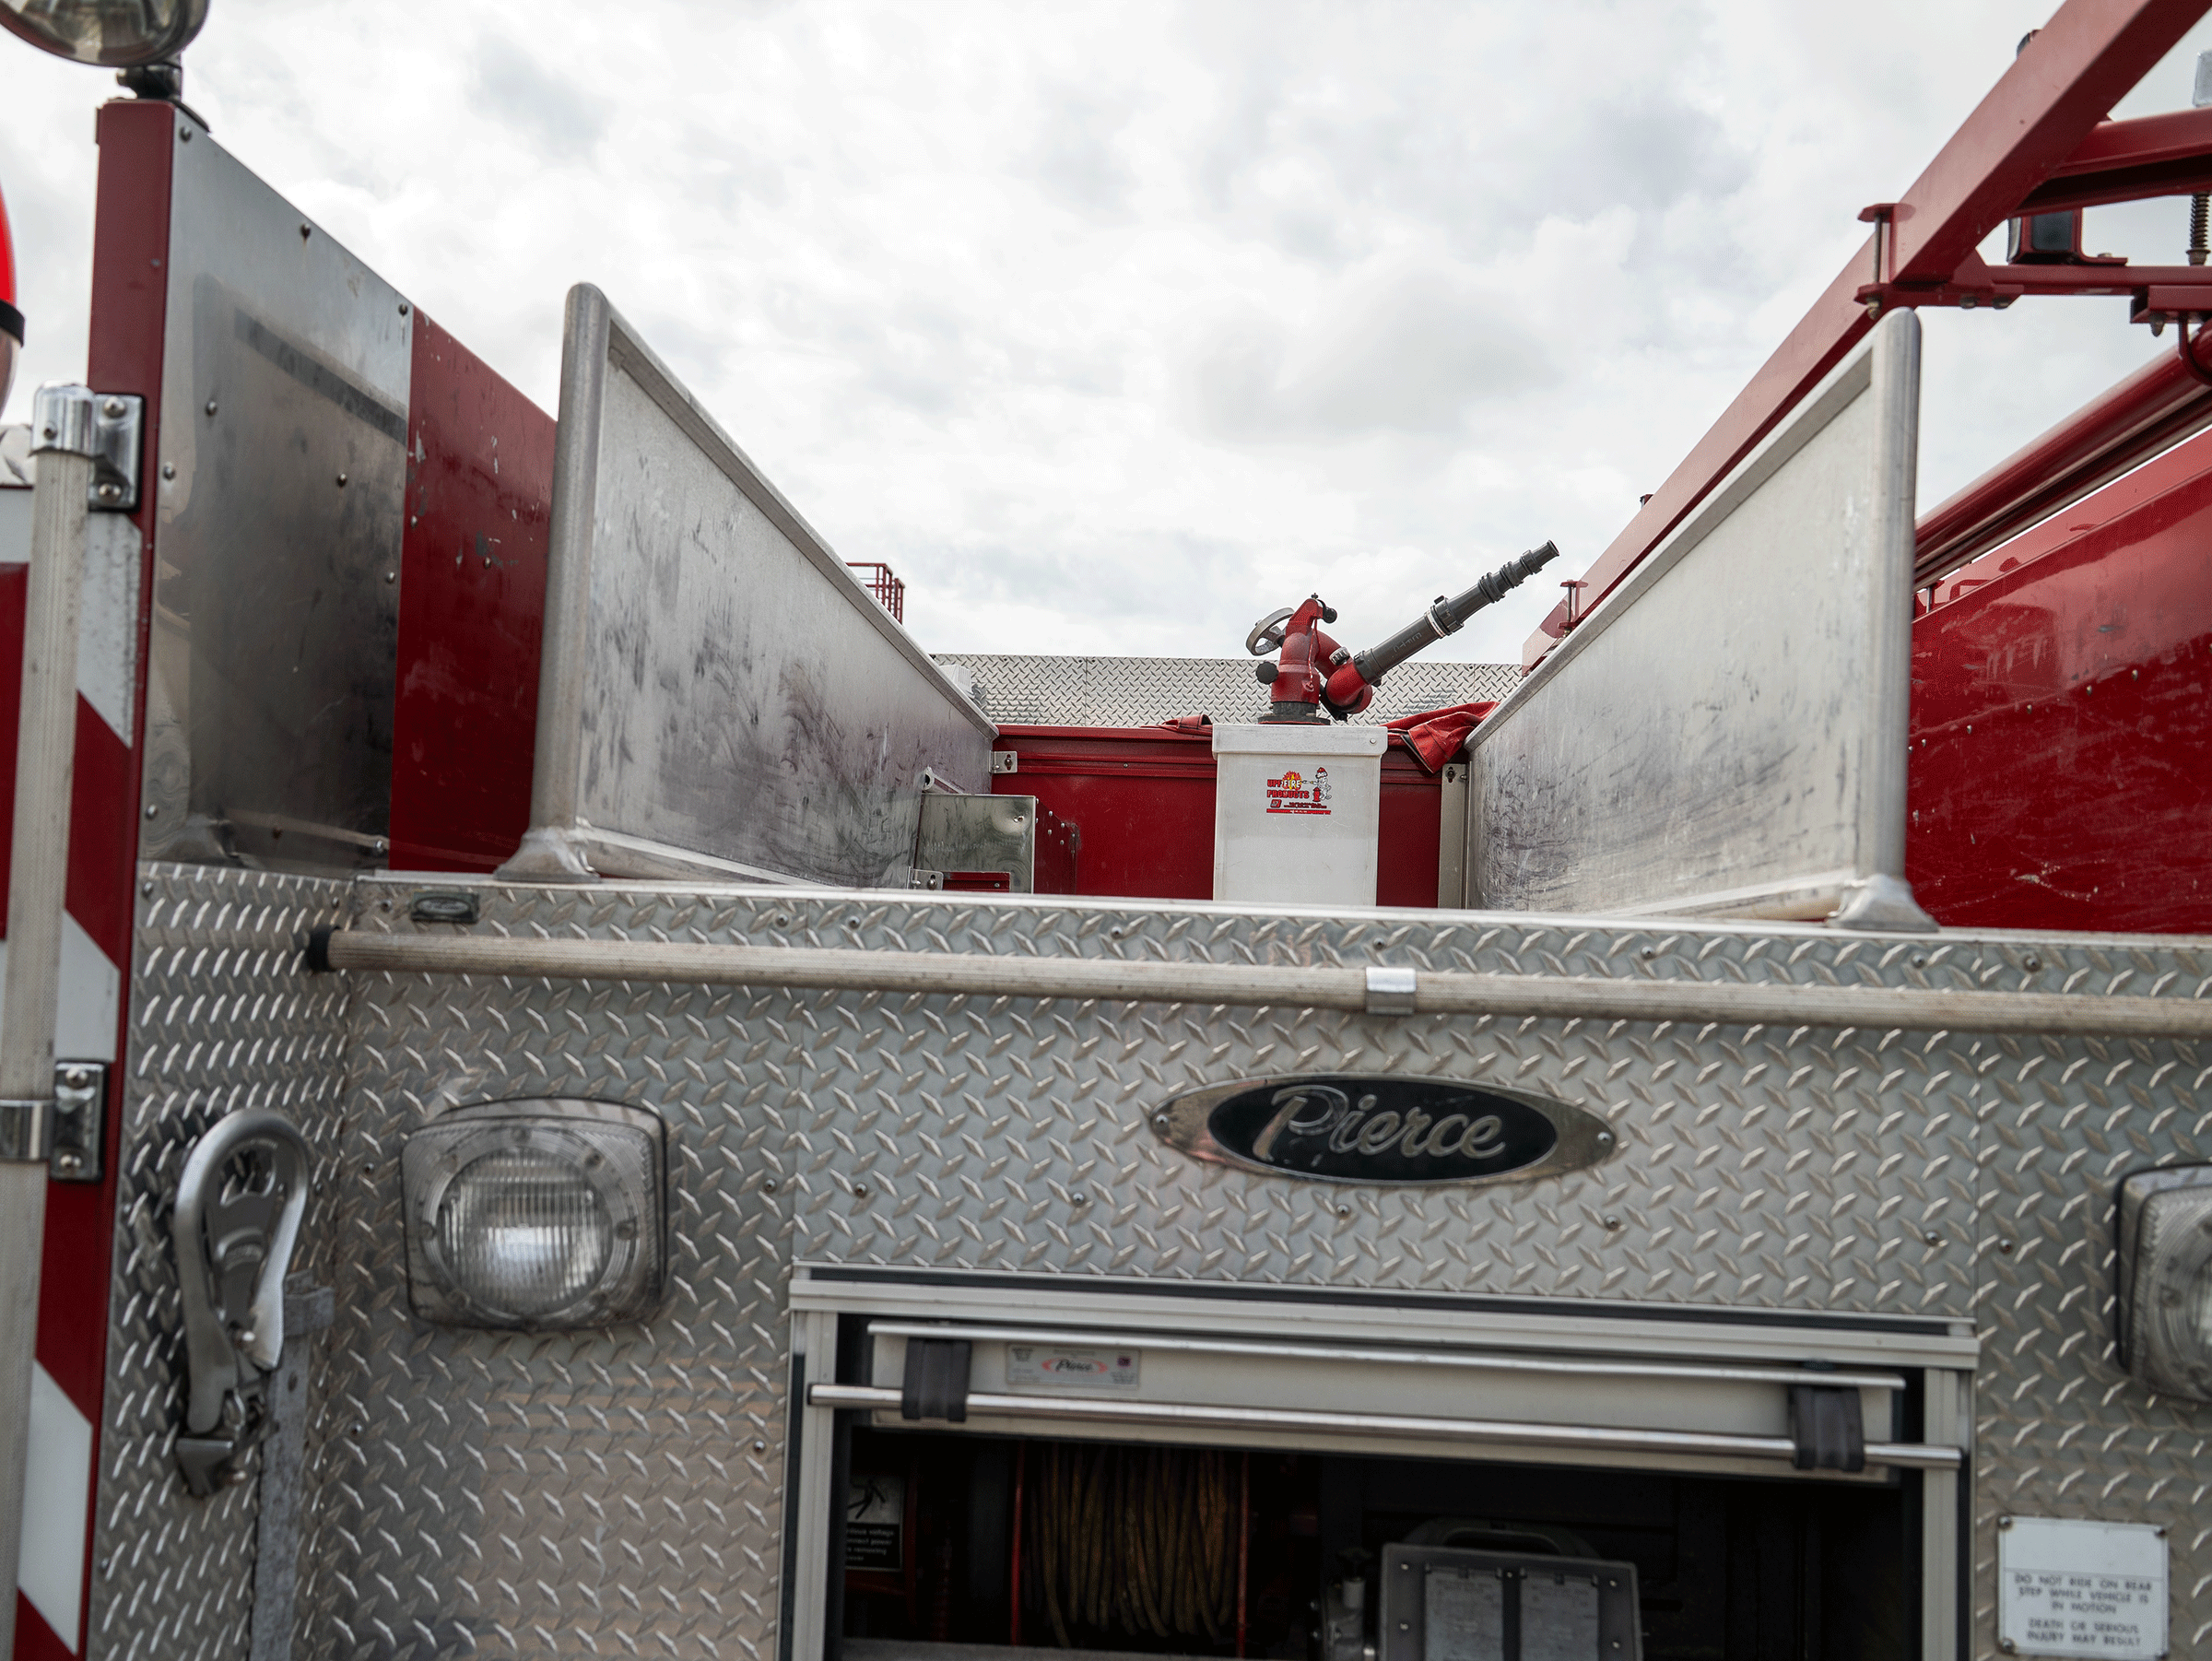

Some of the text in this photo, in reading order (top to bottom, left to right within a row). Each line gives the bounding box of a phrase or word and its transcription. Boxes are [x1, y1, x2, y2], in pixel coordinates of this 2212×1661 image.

[1283, 779, 1300, 788] FIRE
[1266, 790, 1310, 799] PRODUCTS
[1252, 1084, 1506, 1161] Pierce
[2014, 1573, 2152, 1591] DO NOT RIDE ON REAR
[2018, 1585, 2149, 1604] STEP WHILE VEHICLE IS
[2052, 1600, 2117, 1614] IN MOTION
[2029, 1618, 2139, 1634] DEATH OR SERIOUS
[2027, 1630, 2141, 1646] INJURY MAY RESULT
